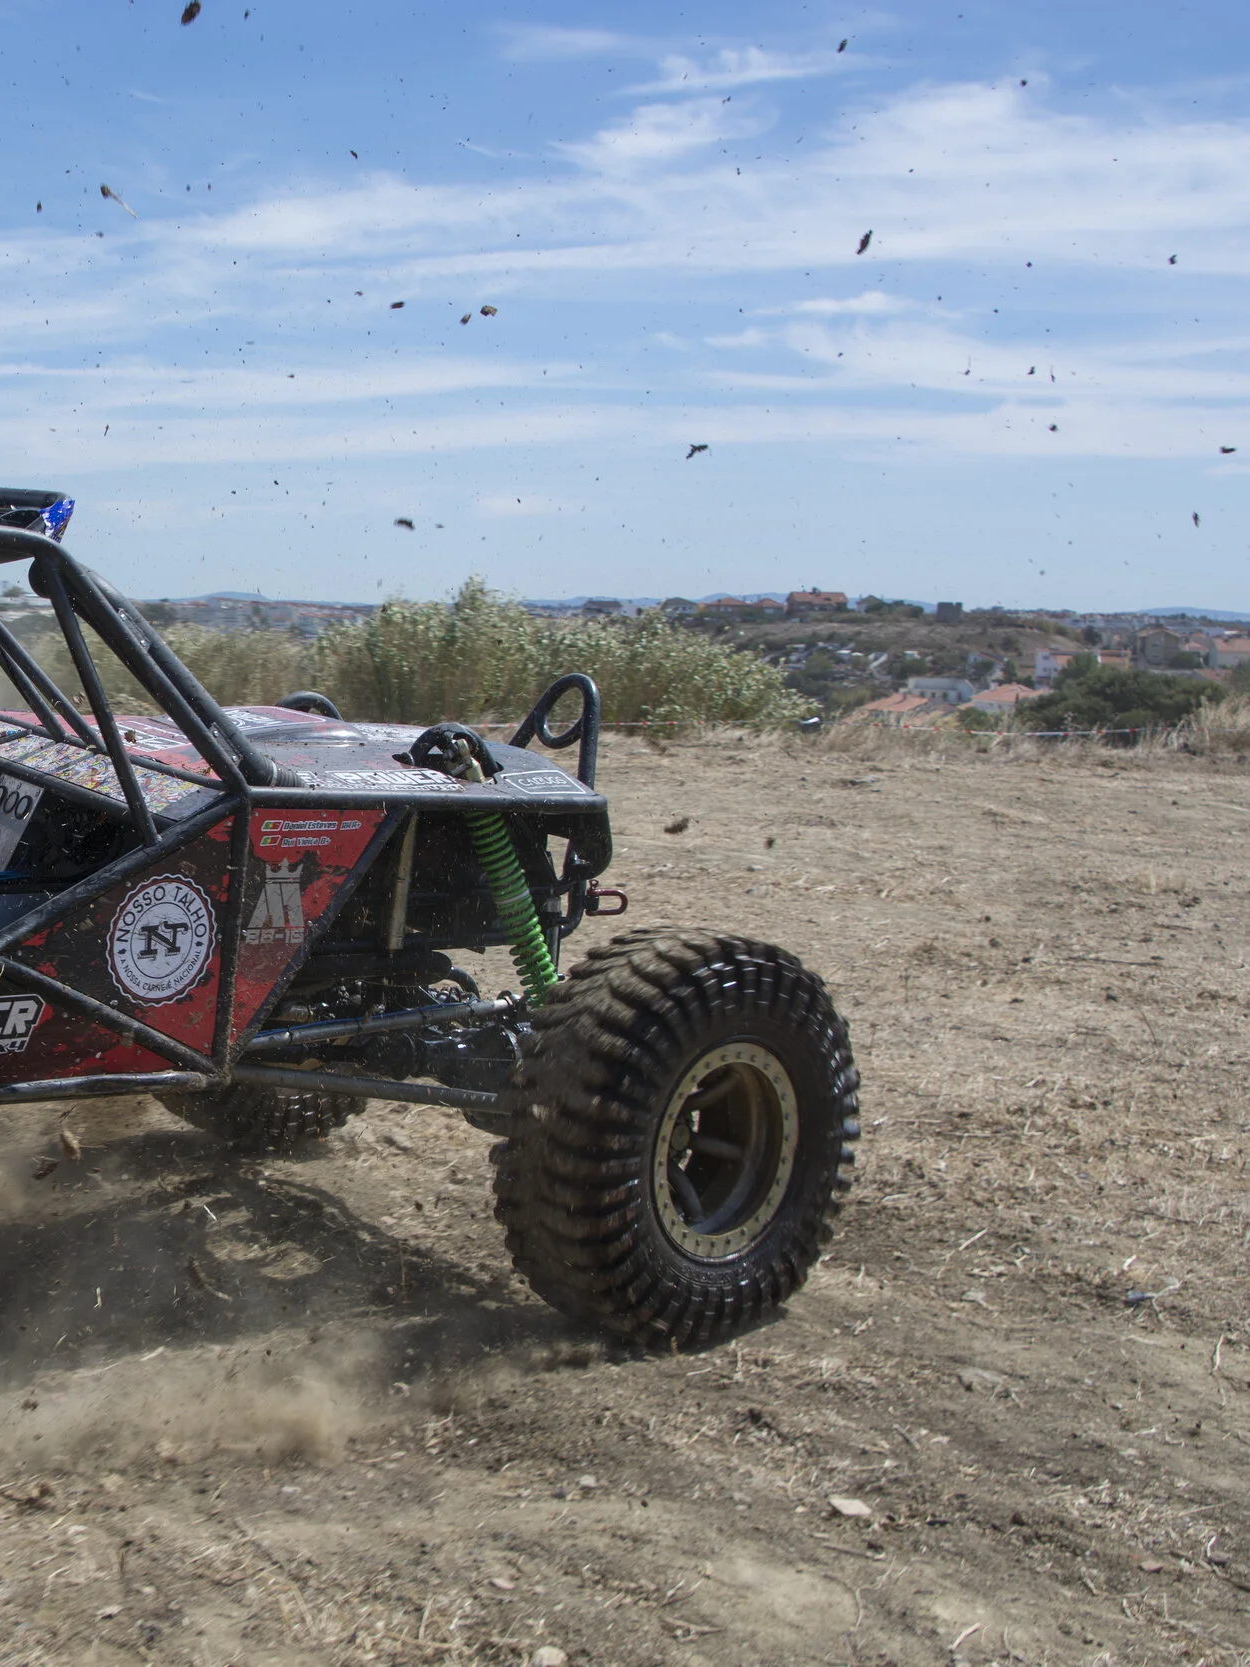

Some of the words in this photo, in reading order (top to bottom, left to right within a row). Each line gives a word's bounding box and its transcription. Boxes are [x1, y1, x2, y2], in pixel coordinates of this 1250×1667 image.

[116, 886, 166, 943] NOSSO
[173, 886, 207, 938] TALHO
[123, 965, 141, 987] NOSSA
[173, 950, 202, 985] NACIONAL
